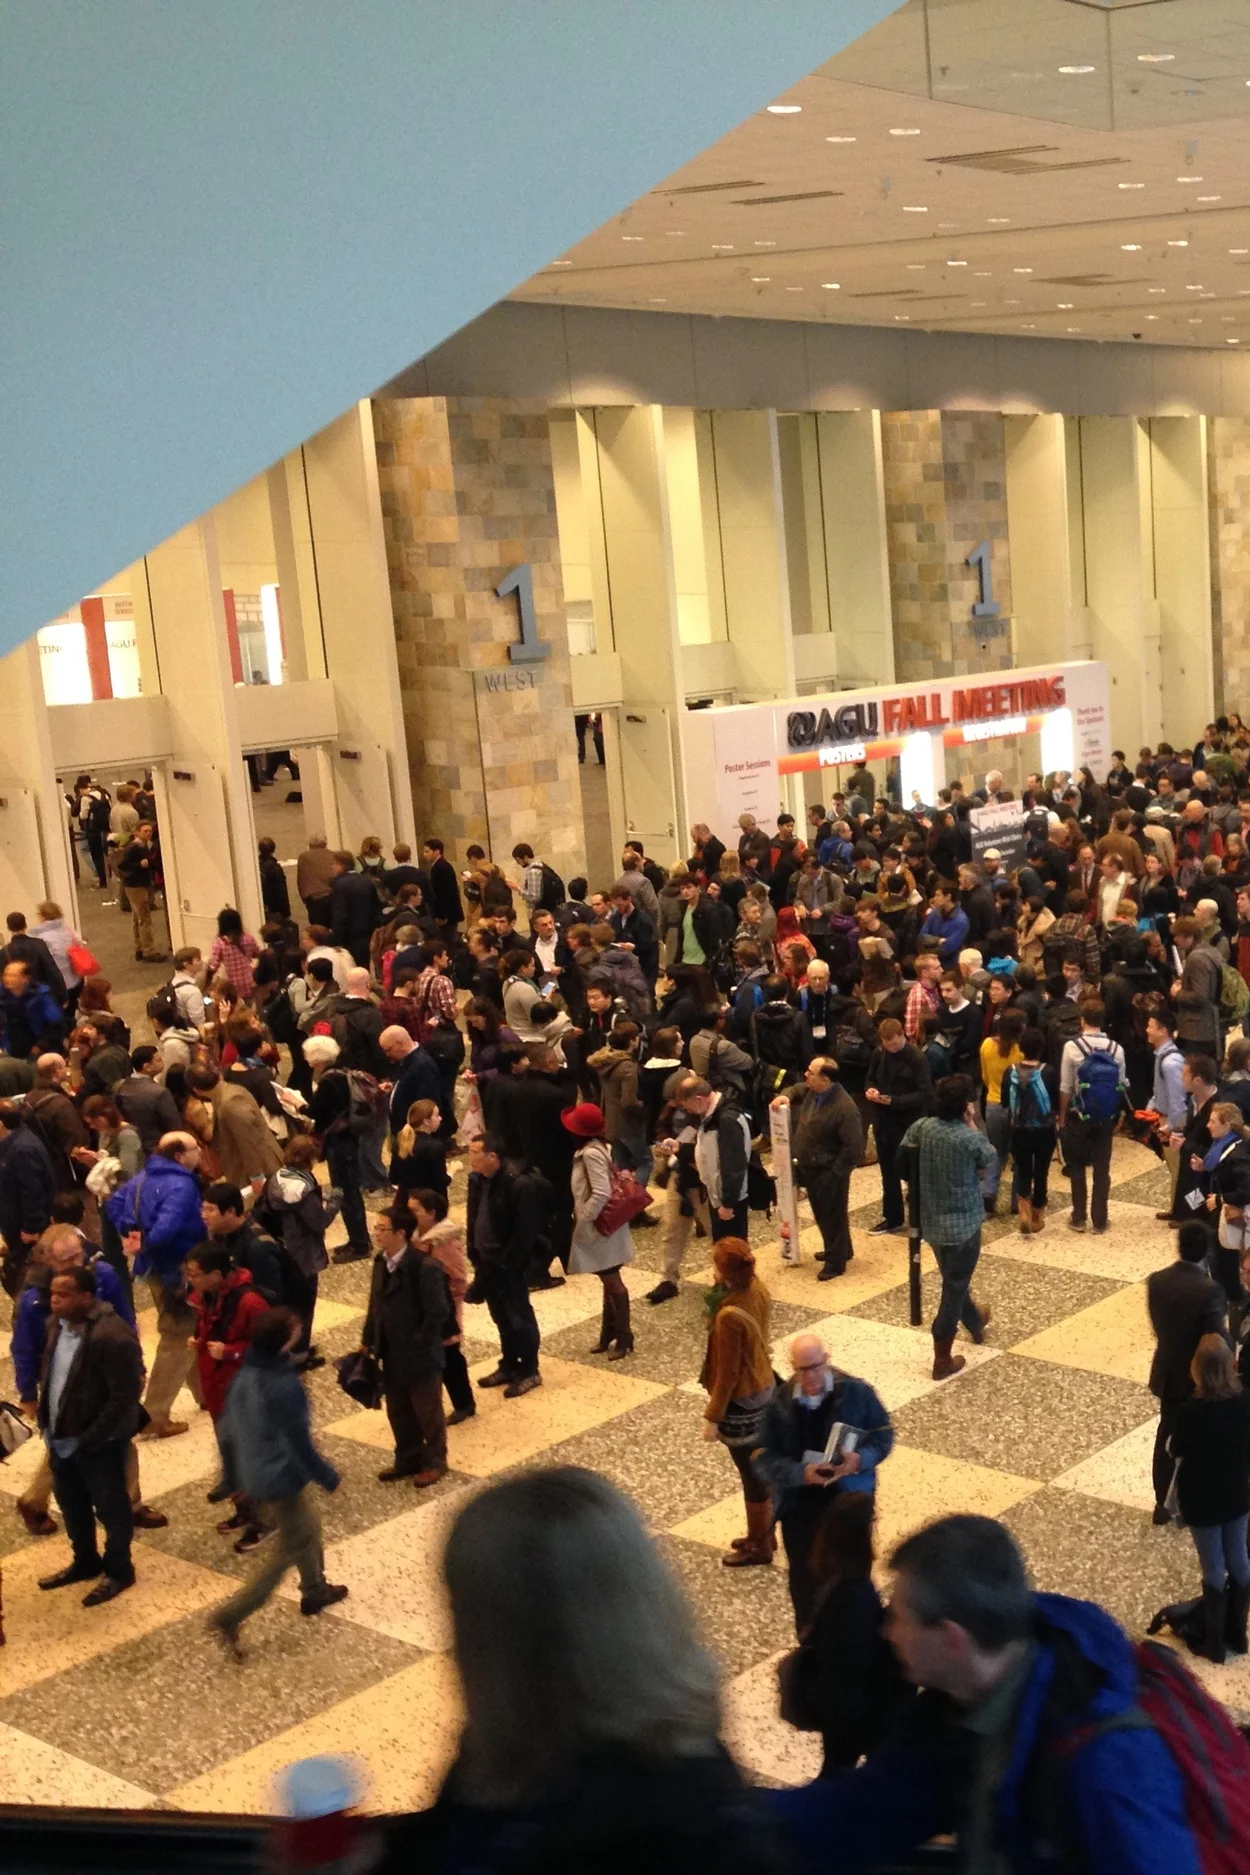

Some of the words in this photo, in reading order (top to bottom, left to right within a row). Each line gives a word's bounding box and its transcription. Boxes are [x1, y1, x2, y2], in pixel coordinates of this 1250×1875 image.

[964, 540, 1001, 616] 1
[493, 563, 552, 665] 1
[484, 670, 536, 693] WEST
[815, 701, 879, 745] AGU
[882, 694, 949, 733] FALL
[952, 675, 1067, 722] MEETING
[724, 763, 745, 774] Poster
[745, 760, 771, 771] Sessions
[818, 742, 866, 767] POSTERS
